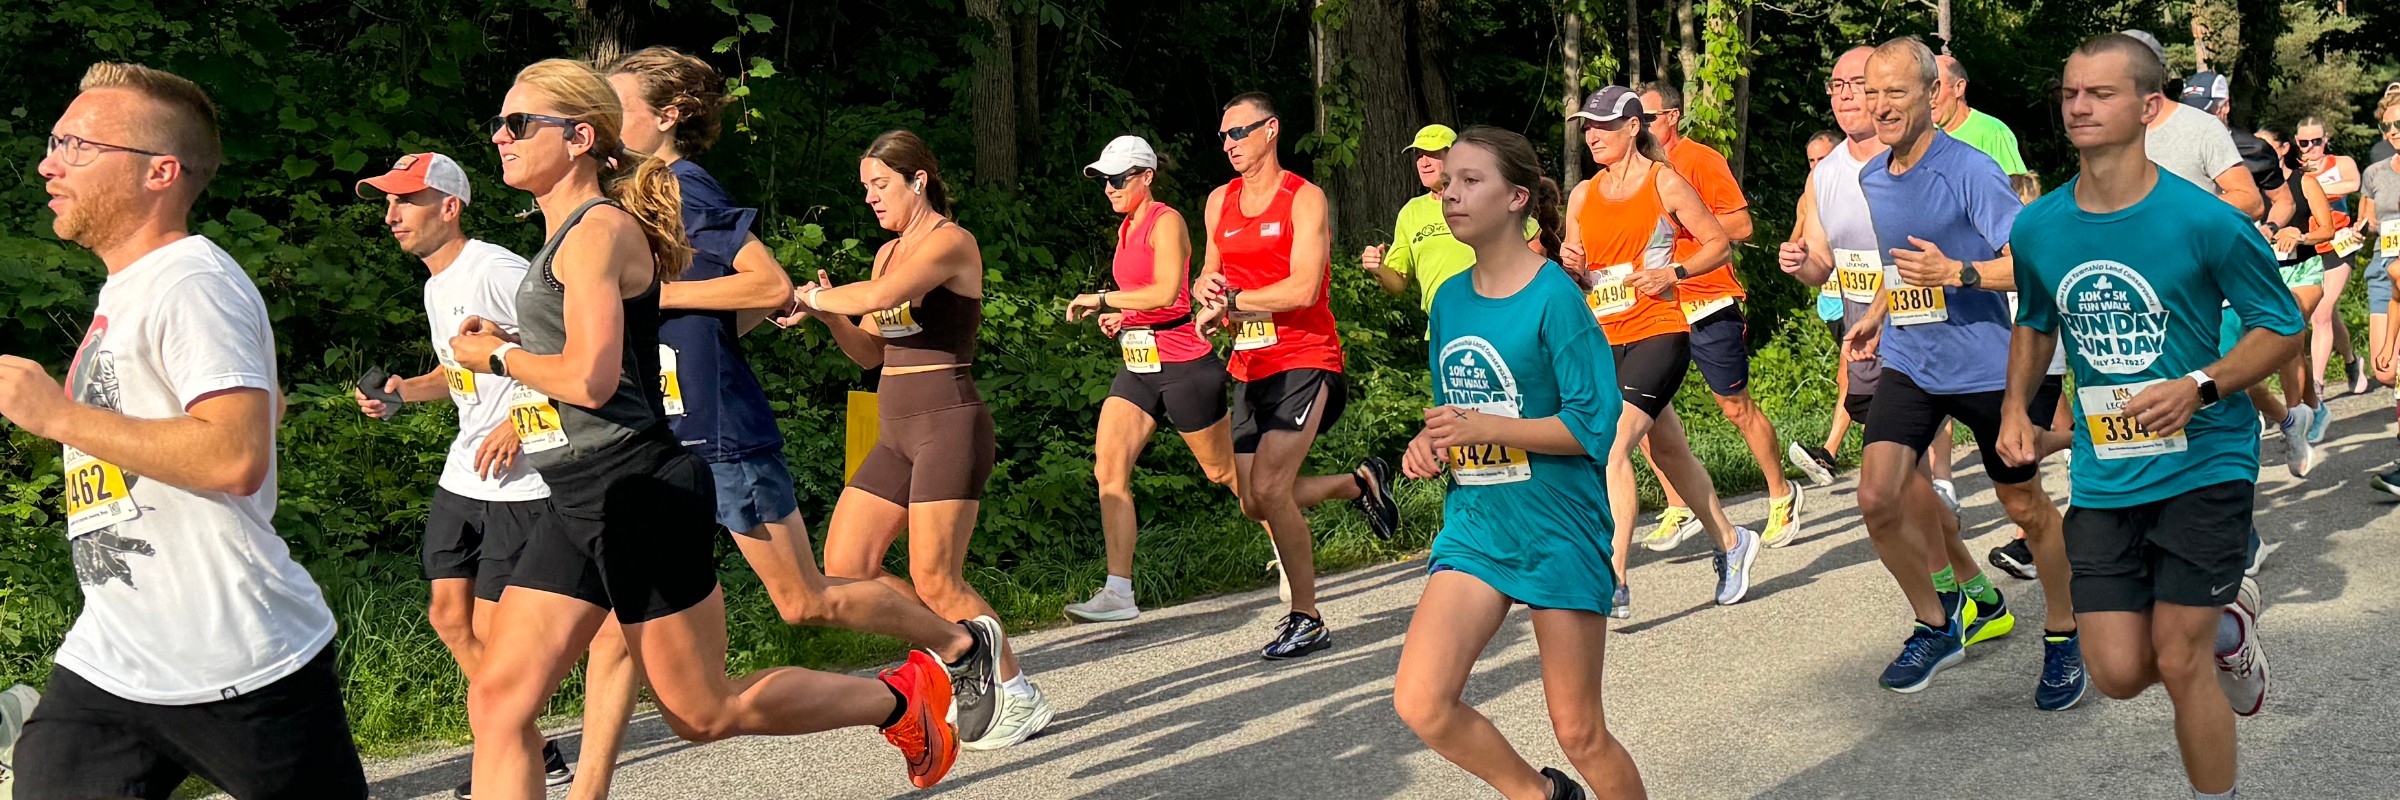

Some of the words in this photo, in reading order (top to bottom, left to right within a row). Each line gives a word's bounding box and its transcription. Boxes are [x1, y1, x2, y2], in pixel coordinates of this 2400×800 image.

[2105, 264, 2123, 274] Land
[1844, 271, 1877, 291] 3397
[1594, 283, 1627, 306] 3498
[1891, 287, 1934, 311] 3380
[2078, 291, 2102, 302] 10K
[2112, 291, 2128, 302] 5K
[2078, 302, 2100, 312] FUN
[2100, 301, 2132, 311] WALK
[2112, 311, 2169, 336] DAY
[2117, 334, 2163, 356] DAY
[1449, 365, 1466, 377] 10K
[1473, 367, 1487, 379] 5K
[1465, 379, 1490, 389] WALK
[2101, 416, 2150, 442] 334
[1457, 443, 1512, 467] 3421
